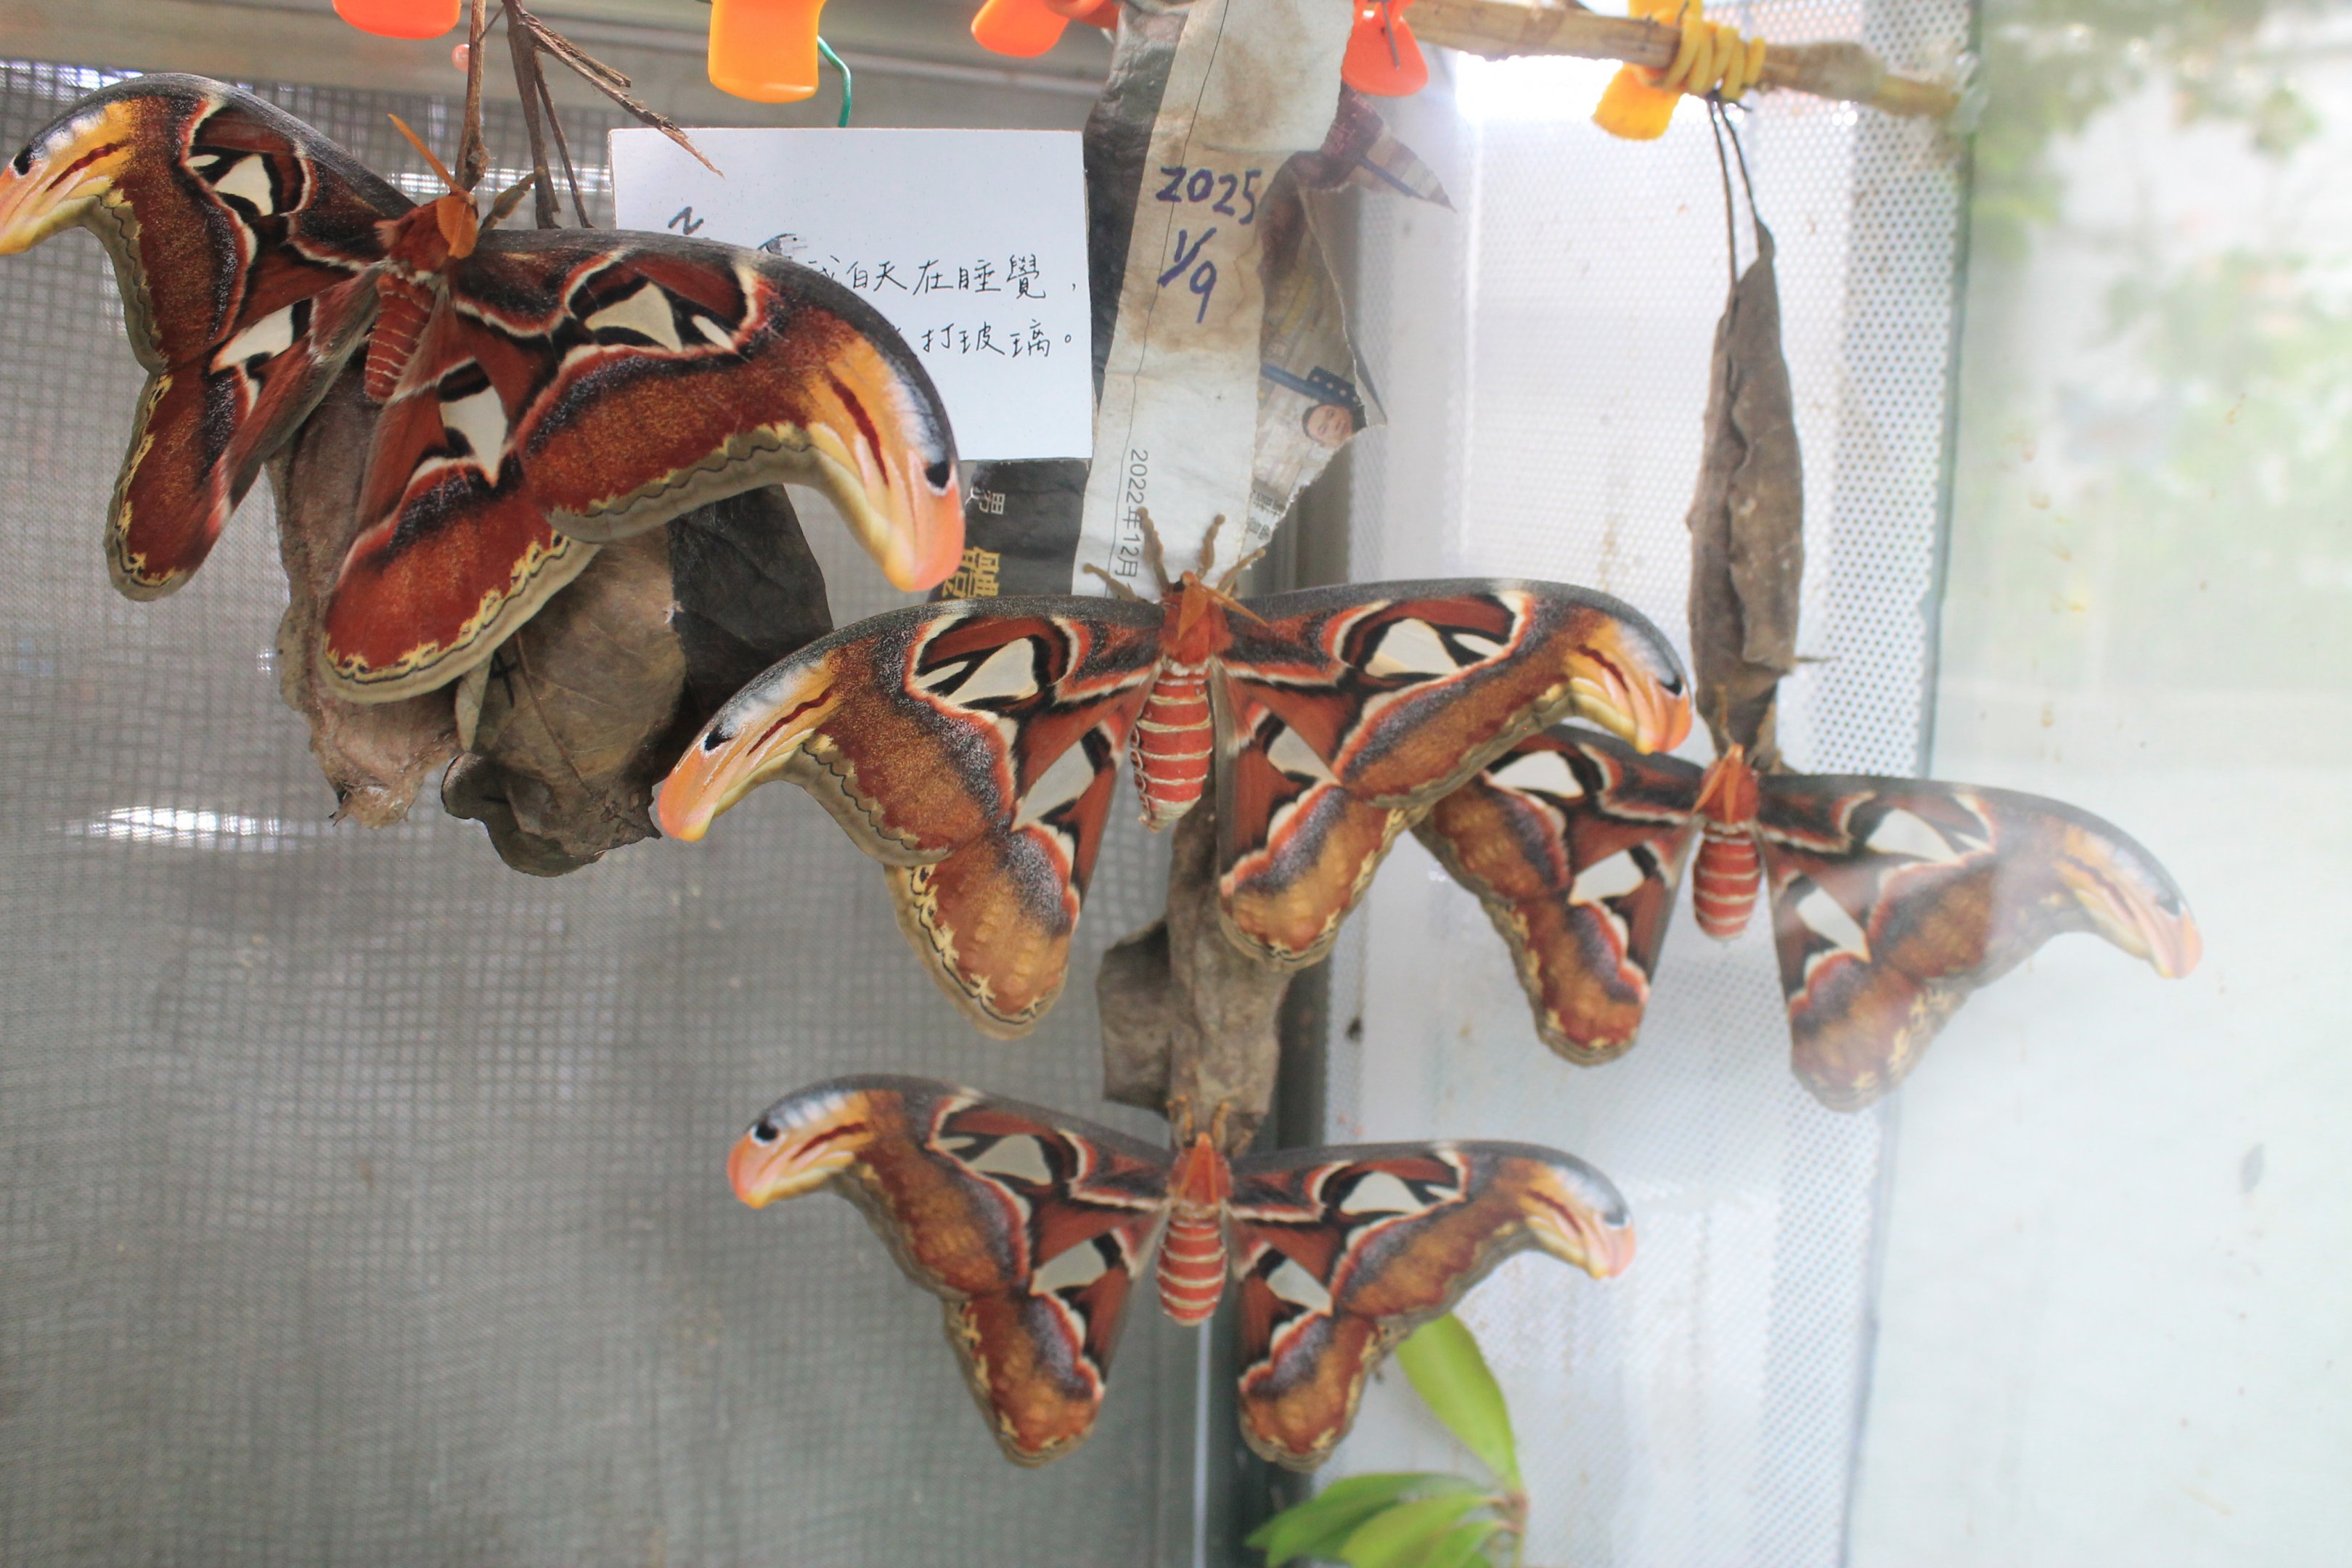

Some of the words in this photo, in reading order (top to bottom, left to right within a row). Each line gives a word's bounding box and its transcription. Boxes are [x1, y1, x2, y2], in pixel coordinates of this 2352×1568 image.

[1156, 166, 1262, 225] 2025
[1157, 227, 1217, 324] 1/9
[895, 319, 1071, 358] 打玻璃。
[1115, 449, 1148, 594] 2022年12月
